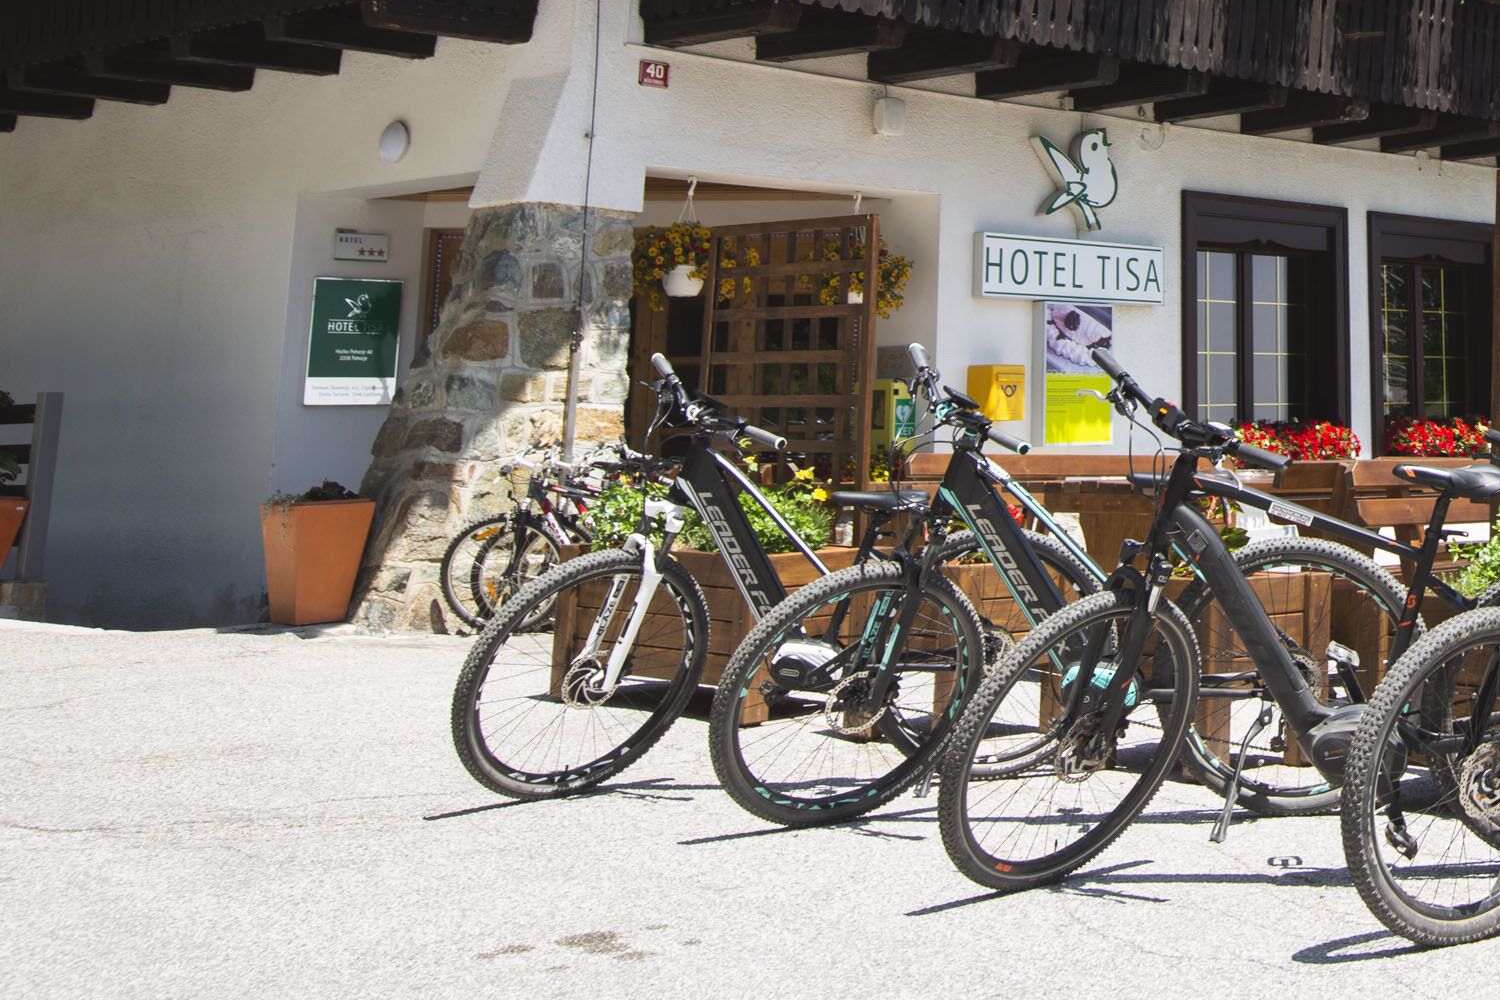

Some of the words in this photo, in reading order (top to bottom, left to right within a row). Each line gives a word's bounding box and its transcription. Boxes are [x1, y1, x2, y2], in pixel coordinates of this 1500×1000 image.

[646, 63, 664, 79] 40
[339, 236, 363, 244] HOTEL
[985, 247, 1083, 288] HOTEL
[1097, 255, 1161, 292] TISA
[328, 321, 359, 332] HOTEL
[697, 491, 758, 586] LEADER
[965, 504, 1039, 603] LEADER
